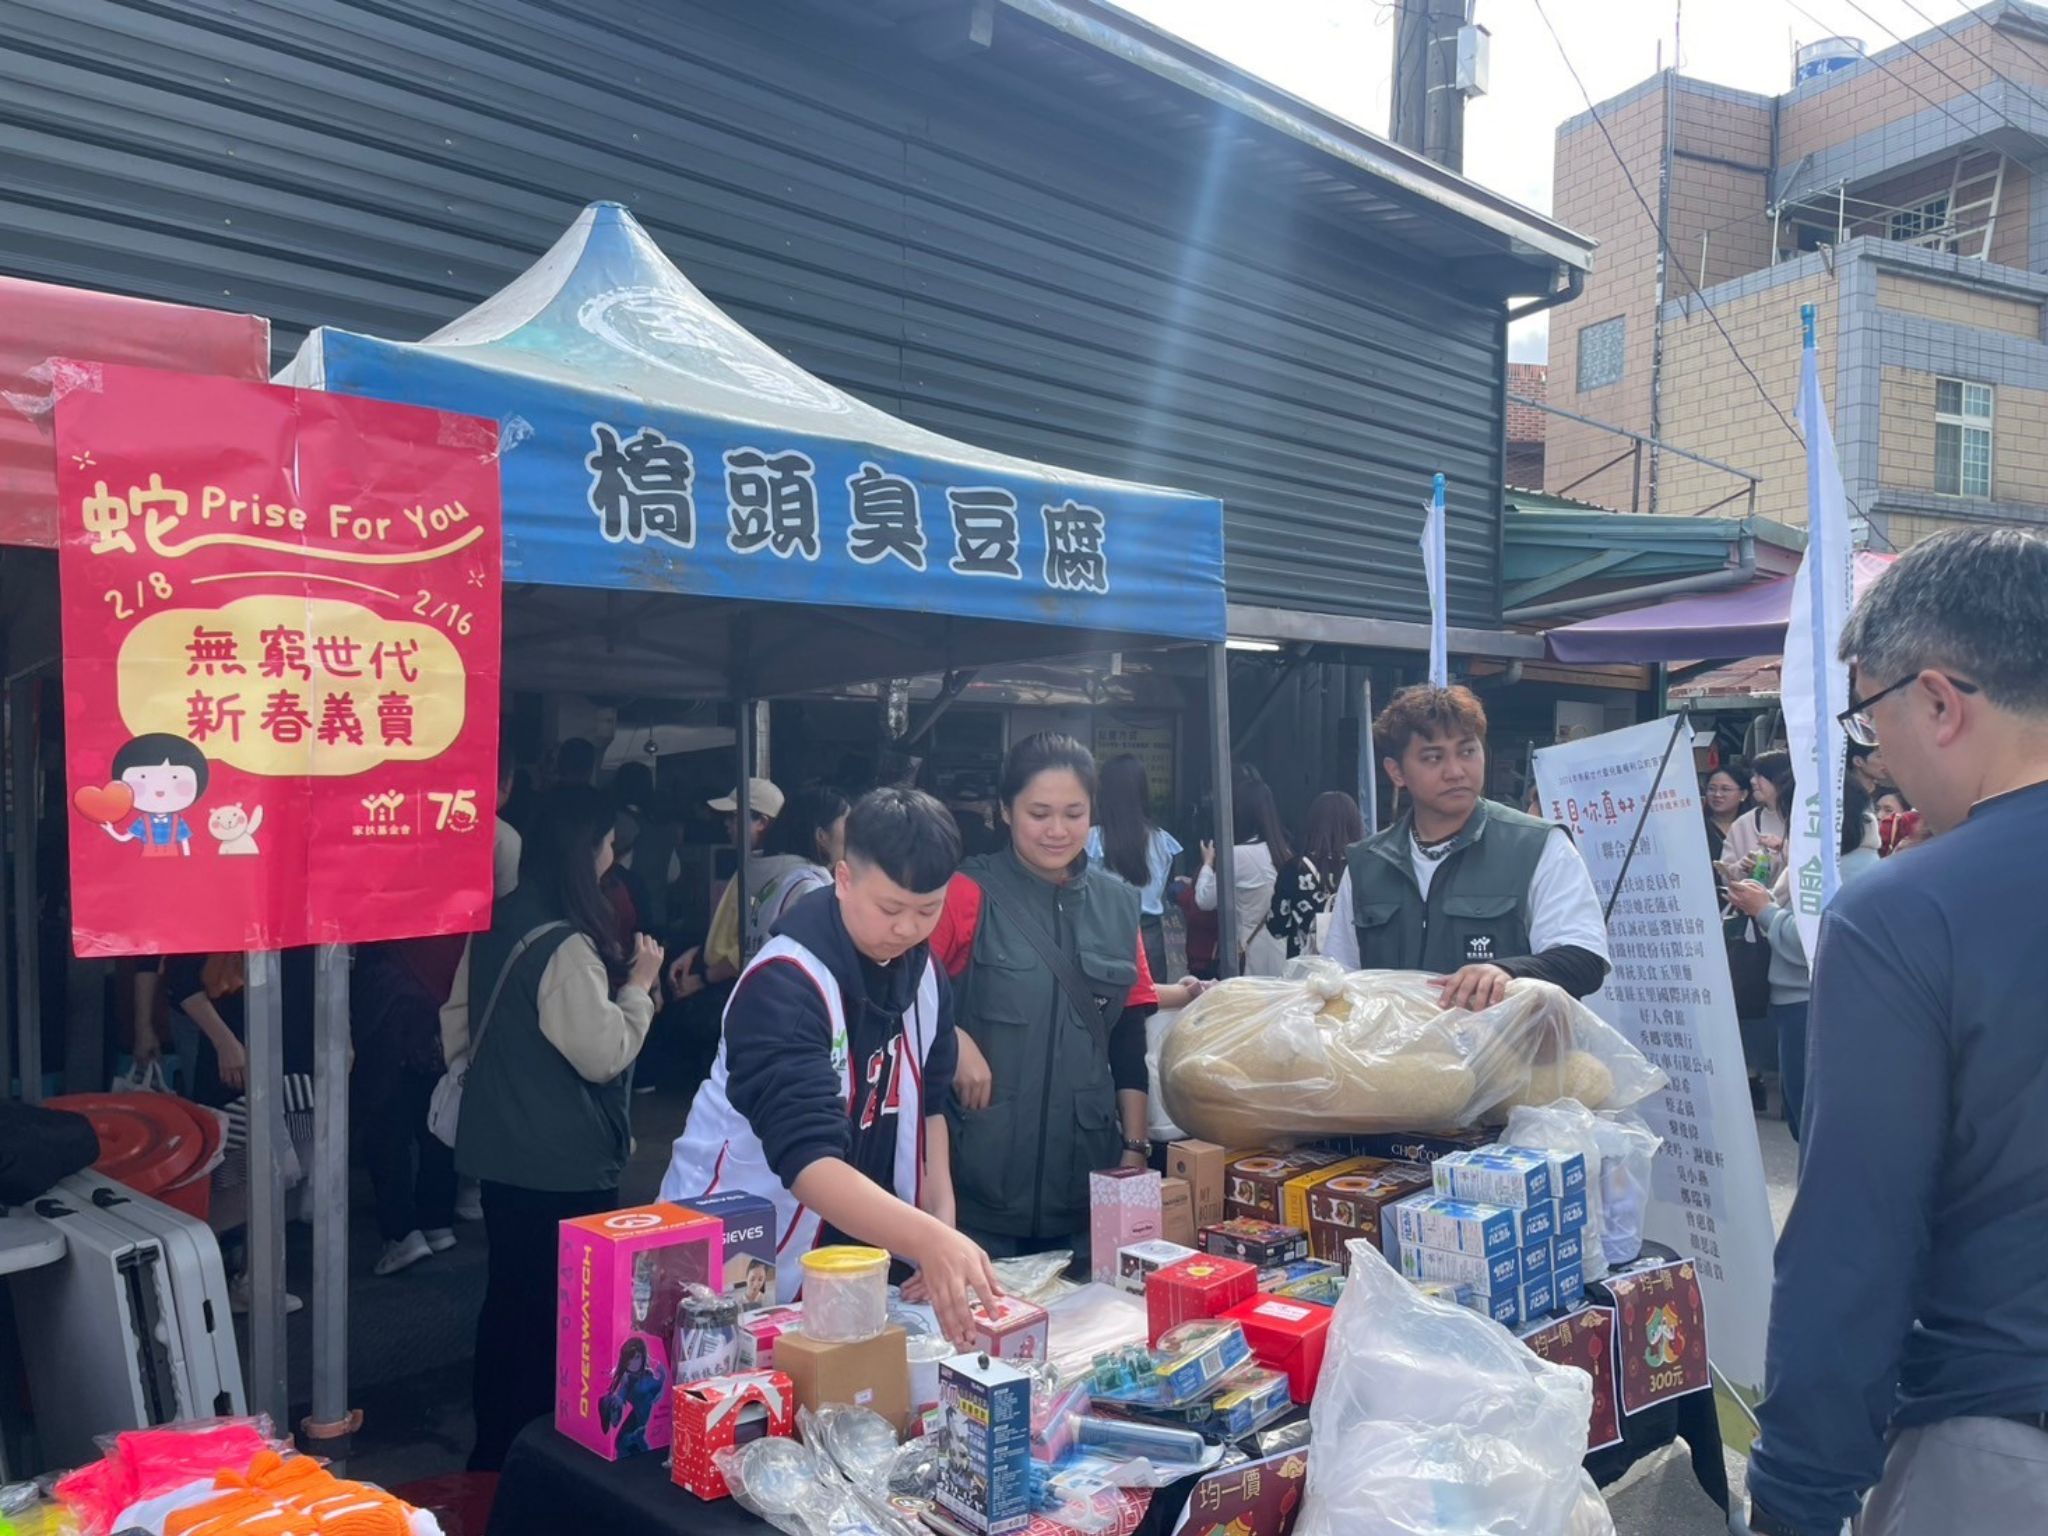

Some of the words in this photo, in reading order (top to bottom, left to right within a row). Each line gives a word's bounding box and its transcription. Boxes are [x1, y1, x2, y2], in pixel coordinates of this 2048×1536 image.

[82, 474, 188, 558] 蛇
[201, 486, 307, 531] Prise
[329, 504, 392, 540] For
[404, 499, 470, 539] You
[586, 422, 1109, 593] 橋頭臭豆腐
[104, 571, 173, 620] 2/8
[413, 590, 473, 635] 2/16
[185, 625, 419, 684] 無窮世代
[186, 688, 414, 746] 新春義賣
[427, 789, 477, 831] 75
[579, 1245, 593, 1418] OVERWATCH
[1650, 1365, 1684, 1392] 300元
[1200, 1468, 1261, 1511] 均一價
